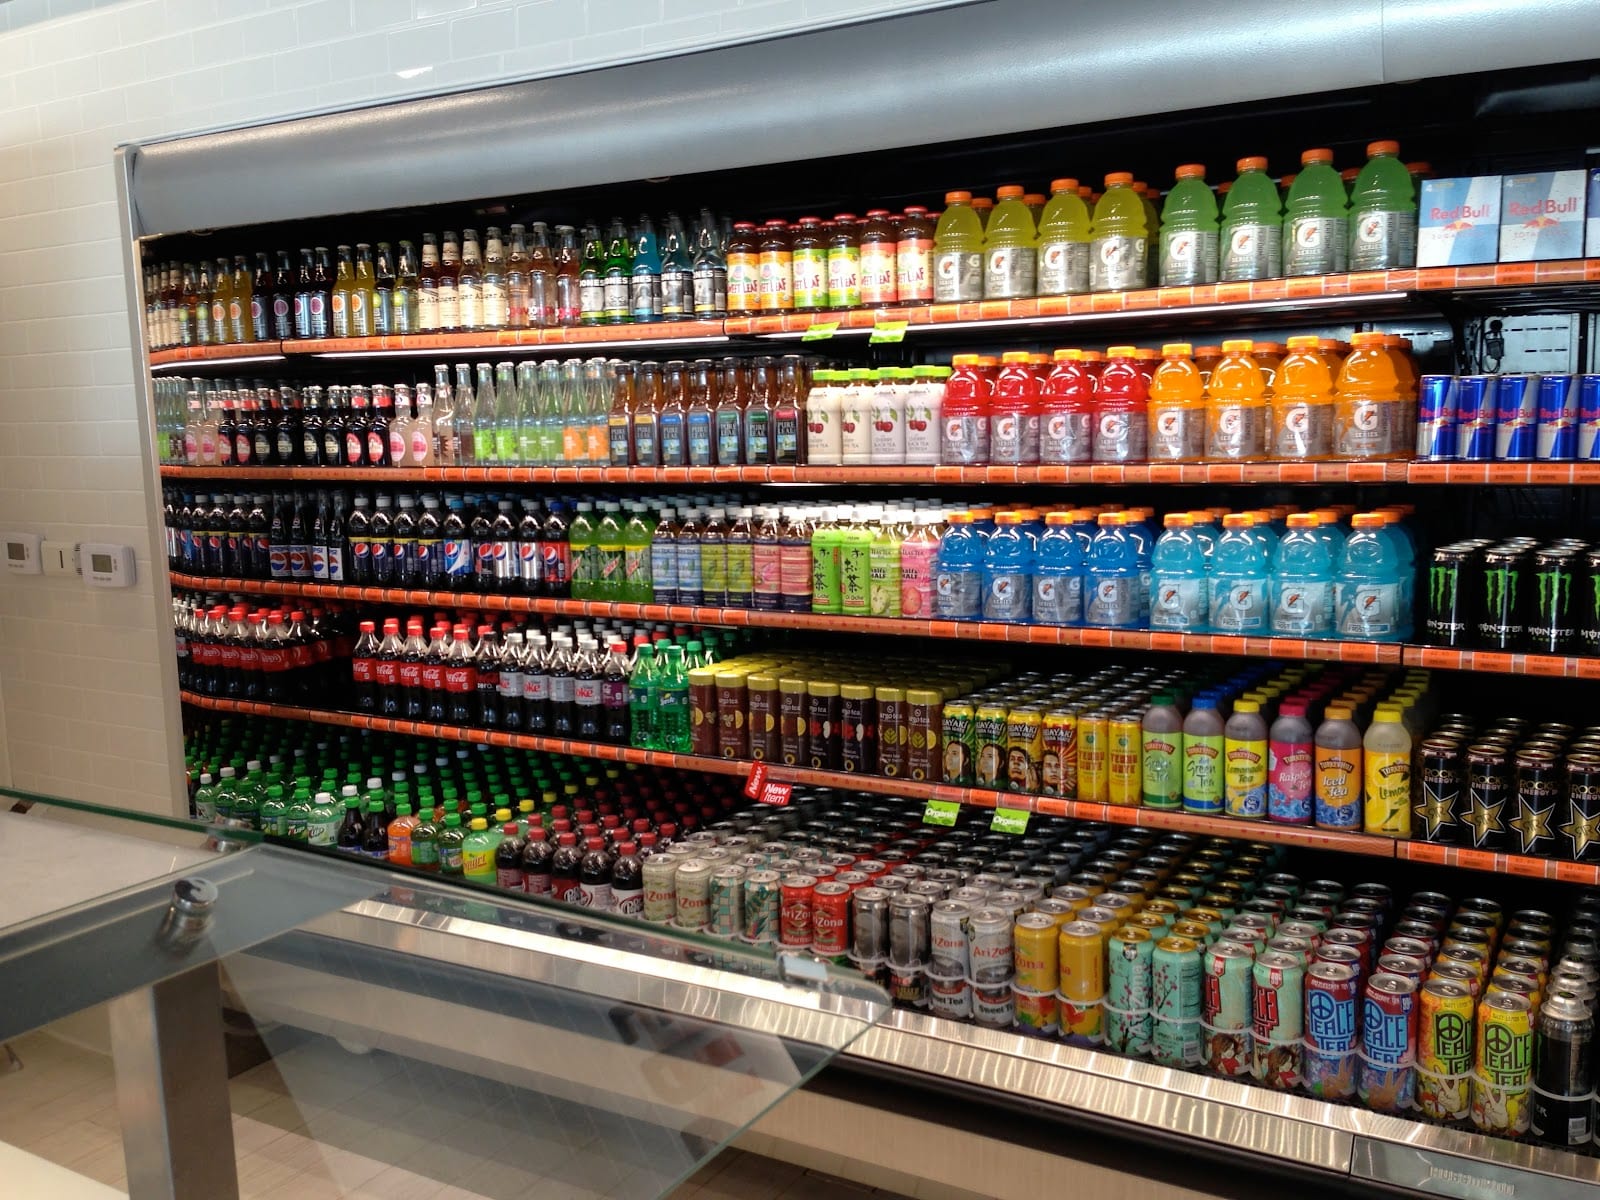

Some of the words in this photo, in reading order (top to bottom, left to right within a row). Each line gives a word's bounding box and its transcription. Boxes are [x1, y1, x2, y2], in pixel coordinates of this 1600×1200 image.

[1430, 207, 1459, 220] Red
[1462, 204, 1490, 218] Bull
[1509, 200, 1542, 216] Red
[1545, 197, 1578, 213] Bull
[1296, 222, 1320, 248] G
[1359, 217, 1383, 243] G
[1170, 236, 1194, 260] G
[1231, 230, 1255, 255] G
[946, 418, 963, 441] G
[997, 417, 1016, 440] G
[1048, 416, 1066, 440] G
[1100, 414, 1120, 439] G
[1157, 411, 1180, 436] G
[1220, 409, 1242, 434] G
[1286, 407, 1309, 433] G
[1354, 404, 1378, 431] G
[937, 574, 951, 595] G
[992, 576, 1014, 600] G
[1038, 578, 1055, 601] G
[1098, 579, 1117, 602] G
[1159, 584, 1180, 610] G
[1229, 584, 1253, 610] G
[1281, 586, 1304, 613] G
[1355, 588, 1381, 616] G
[749, 766, 762, 795] New
[764, 783, 790, 795] New
[1238, 774, 1253, 783] Tea
[1323, 774, 1346, 787] Iced
[764, 793, 785, 804] Item
[1329, 786, 1348, 797] Tea
[993, 815, 1026, 828] Organic
[782, 907, 811, 919] AriZon
